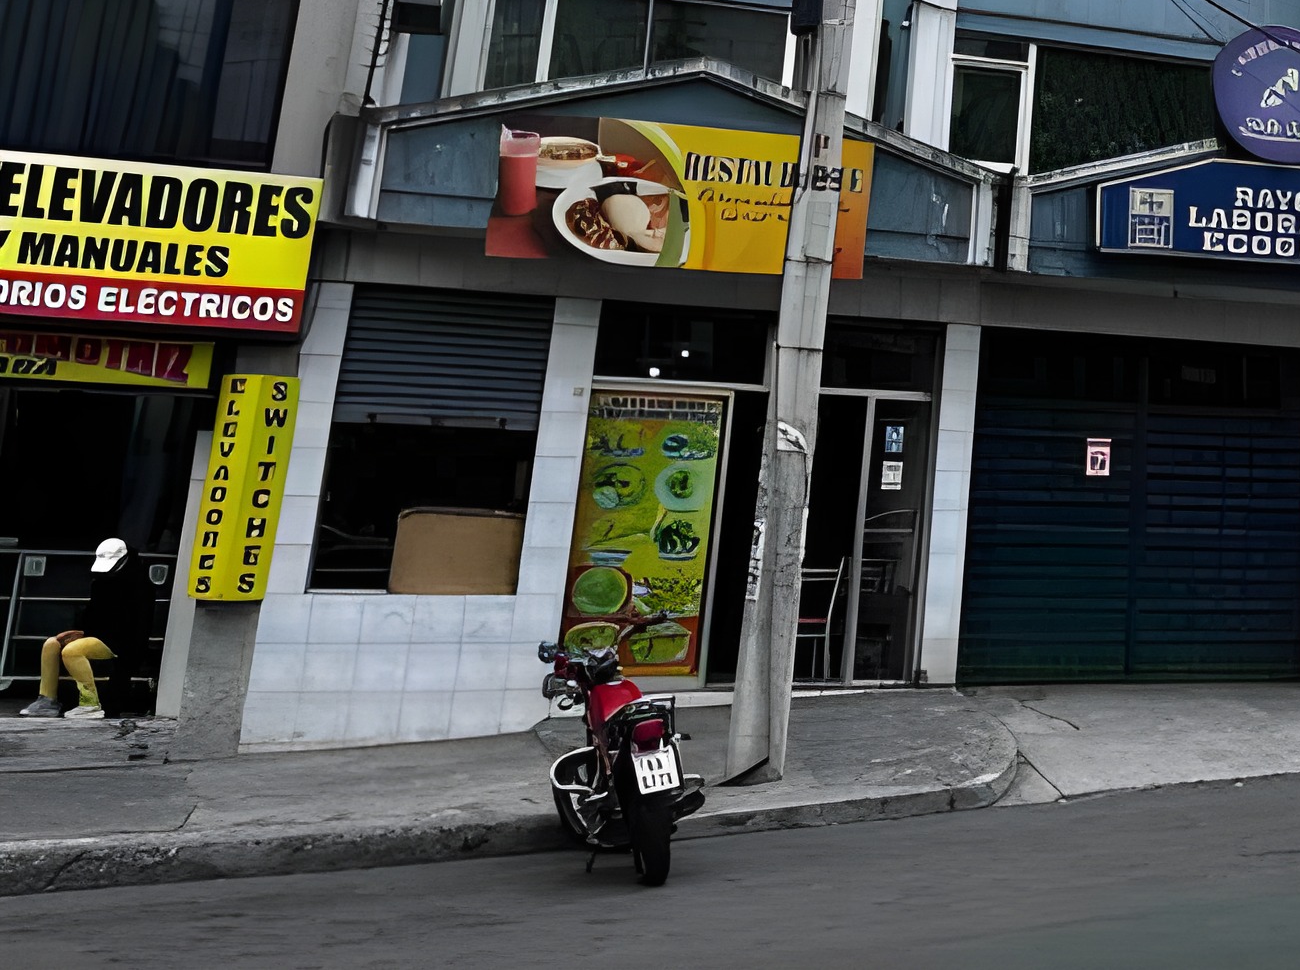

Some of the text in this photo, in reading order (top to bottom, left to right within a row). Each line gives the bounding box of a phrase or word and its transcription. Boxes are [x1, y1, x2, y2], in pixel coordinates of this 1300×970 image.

[0, 161, 314, 239] ELEVADORES
[17, 231, 230, 277] MANUALES
[97, 286, 294, 322] ELECTRICOS
[237, 381, 288, 594] SWITCHES
